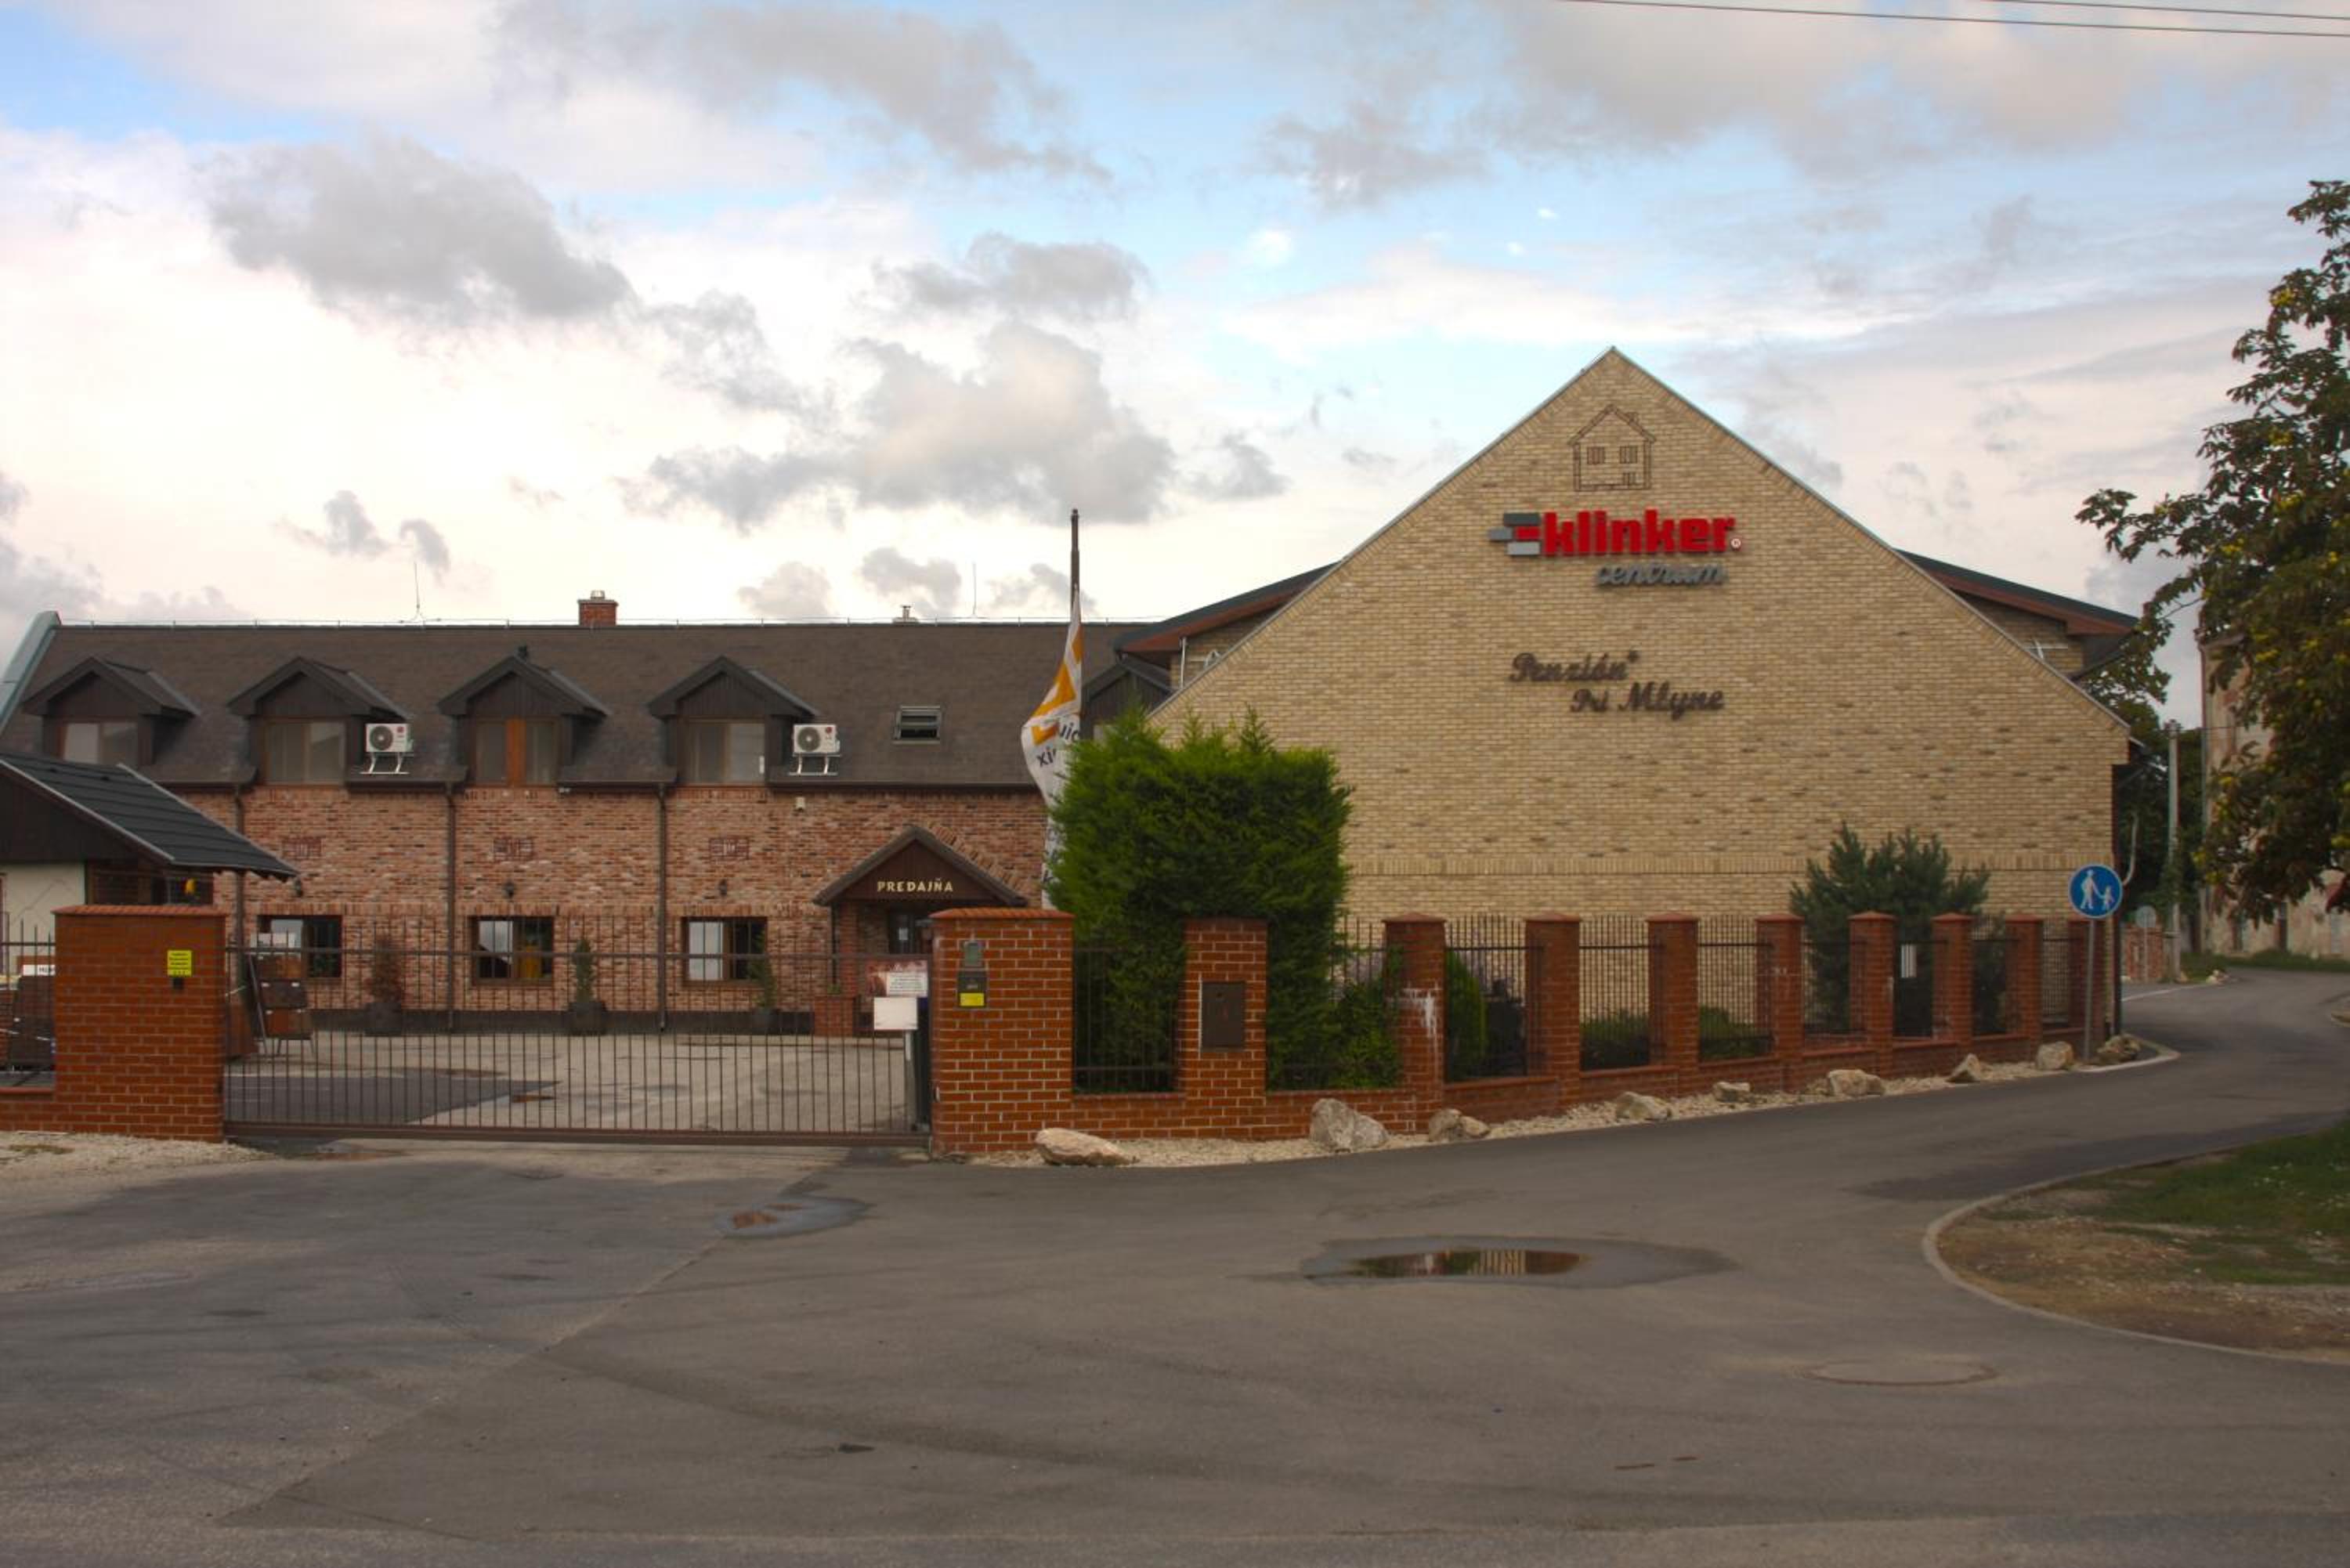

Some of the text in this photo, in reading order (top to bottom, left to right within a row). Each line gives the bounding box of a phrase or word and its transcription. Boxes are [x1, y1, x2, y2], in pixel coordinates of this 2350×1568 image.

[1544, 509, 1736, 555] klinker
[1599, 564, 1729, 587] centrum
[1618, 681, 1725, 720] Mlyne
[877, 876, 953, 892] PREDAJŇA
